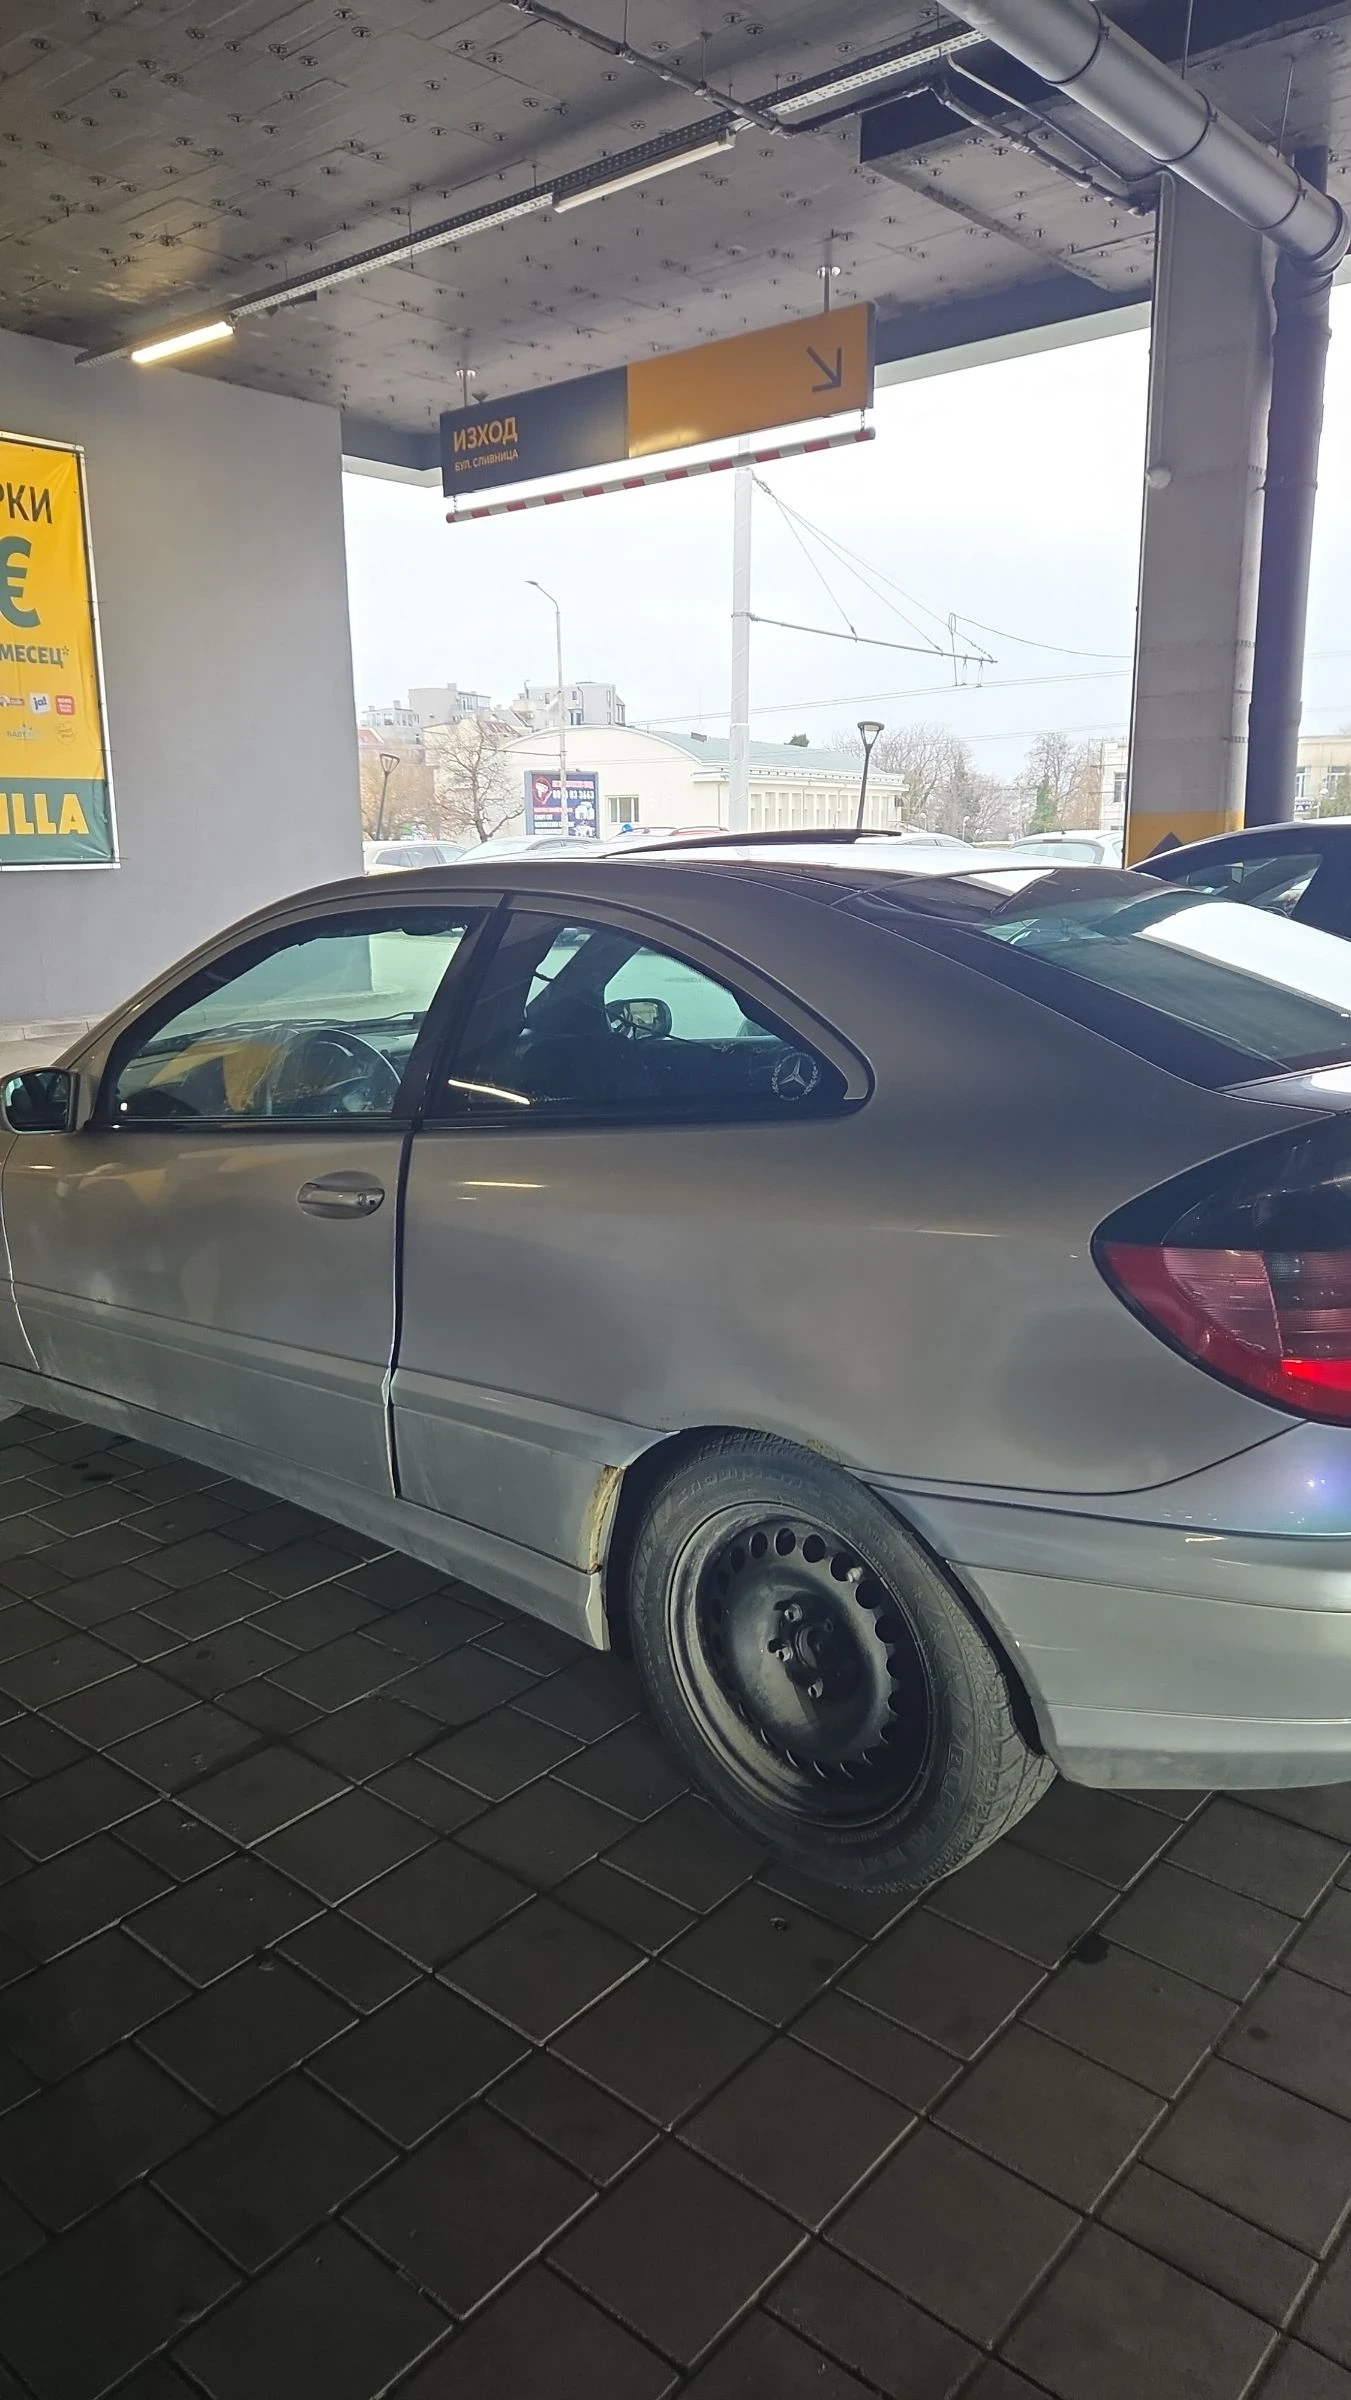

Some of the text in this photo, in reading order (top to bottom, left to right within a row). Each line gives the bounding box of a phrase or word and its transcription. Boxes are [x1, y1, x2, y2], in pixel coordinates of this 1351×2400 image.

[453, 416, 519, 453] ИЗХОД
[454, 448, 519, 472] БУЛ. СЛИВНИЦА
[32, 696, 48, 711] ja!
